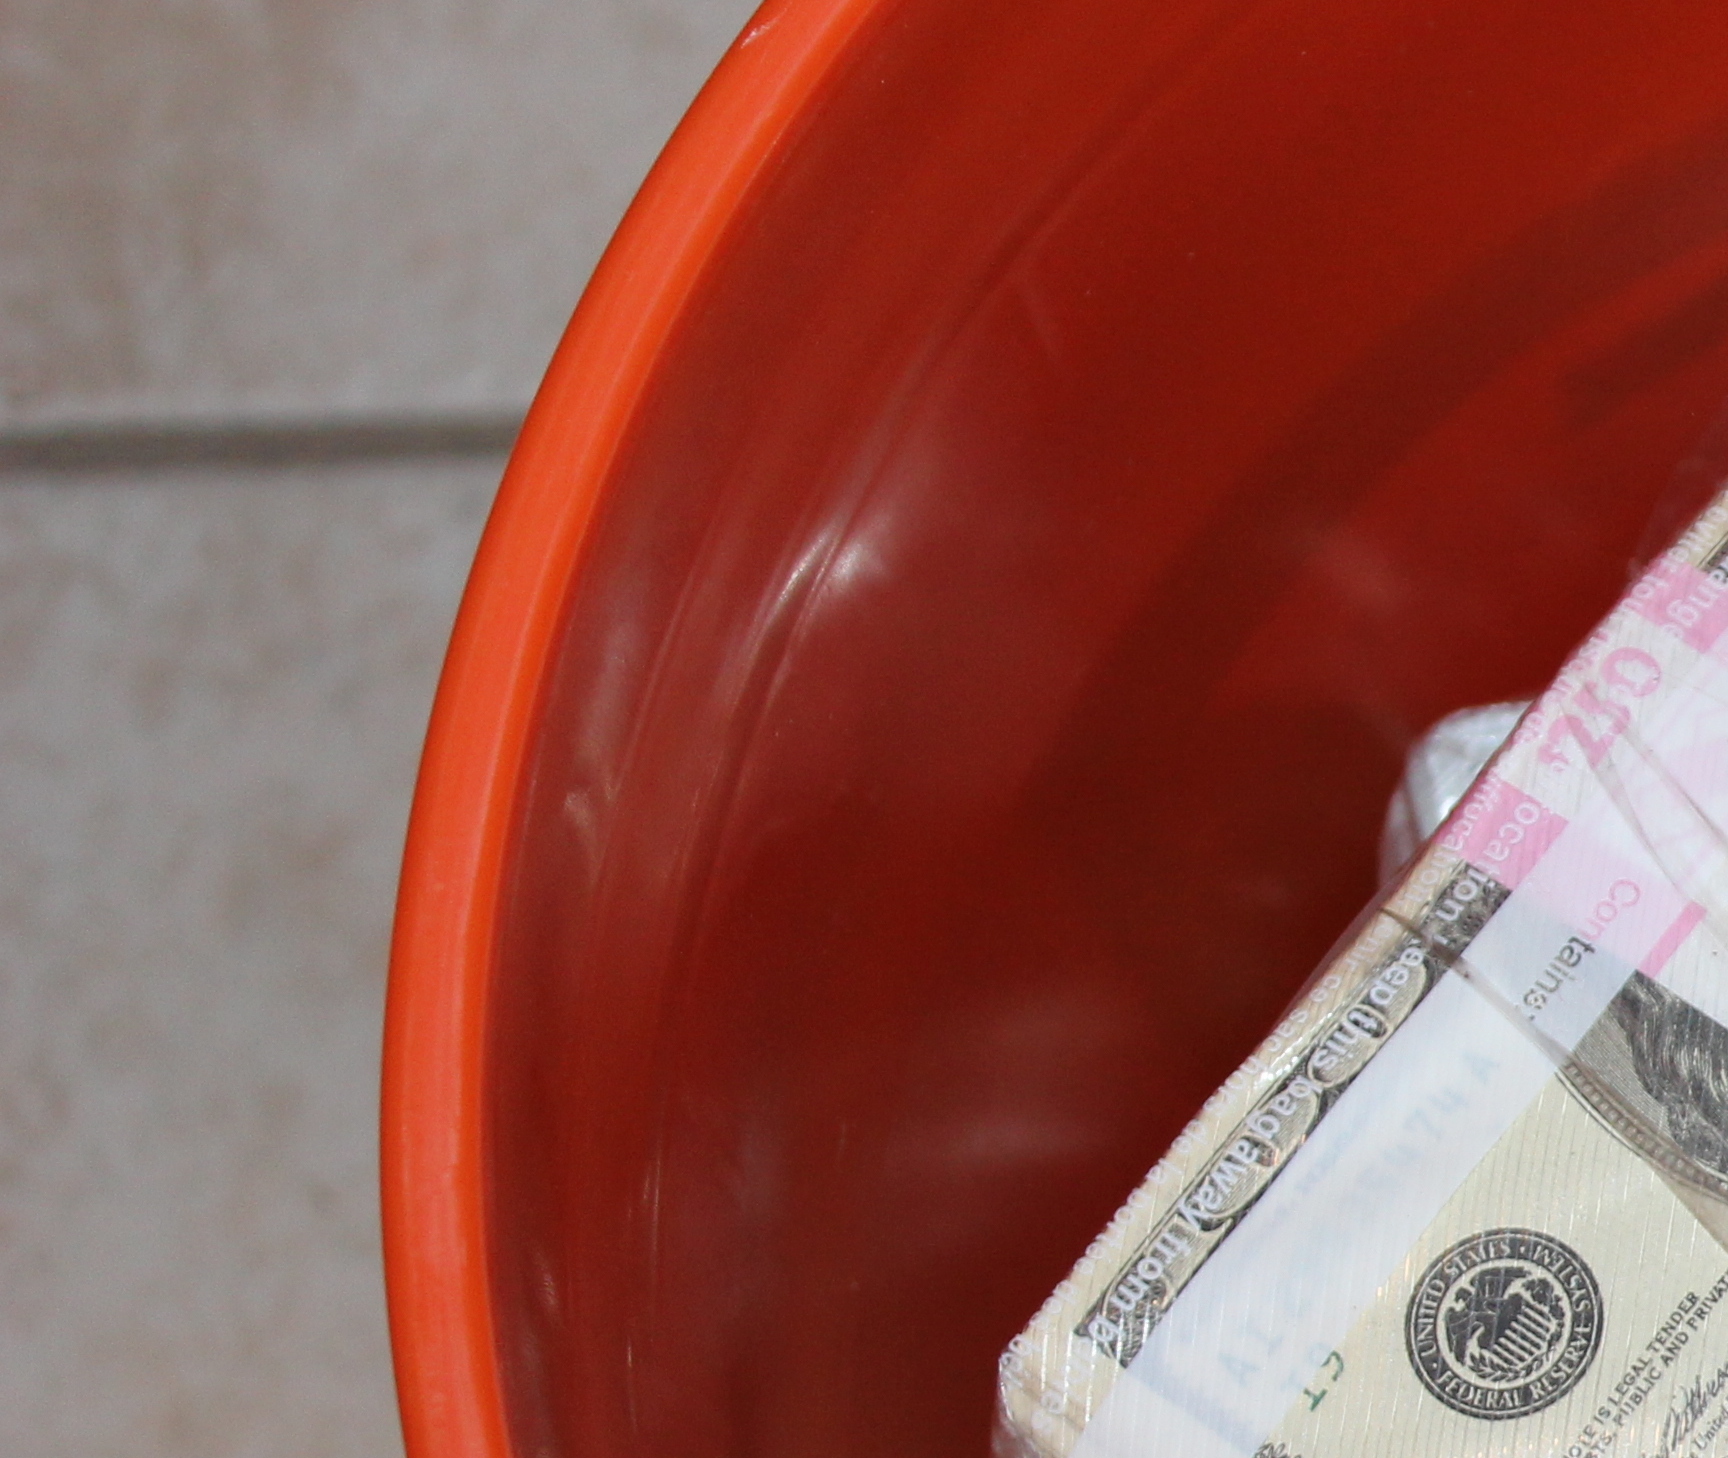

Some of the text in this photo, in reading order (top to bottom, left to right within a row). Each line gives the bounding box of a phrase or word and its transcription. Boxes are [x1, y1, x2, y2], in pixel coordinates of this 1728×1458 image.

[1304, 1001, 1382, 1084] this
[1242, 1065, 1325, 1152] bag
[1169, 1128, 1267, 1233] away
[1104, 1226, 1194, 1323] from
[1416, 1240, 1509, 1354] UNITED STATES
[1435, 1235, 1590, 1410] FEDERAL RESERVE SYSTEM
[1591, 1403, 1614, 1427] IS
[1603, 1350, 1656, 1411] LEGAL
[1643, 1287, 1703, 1358] TENDER
[1608, 1363, 1667, 1431] PUBLIC
[1655, 1327, 1693, 1369] AND
